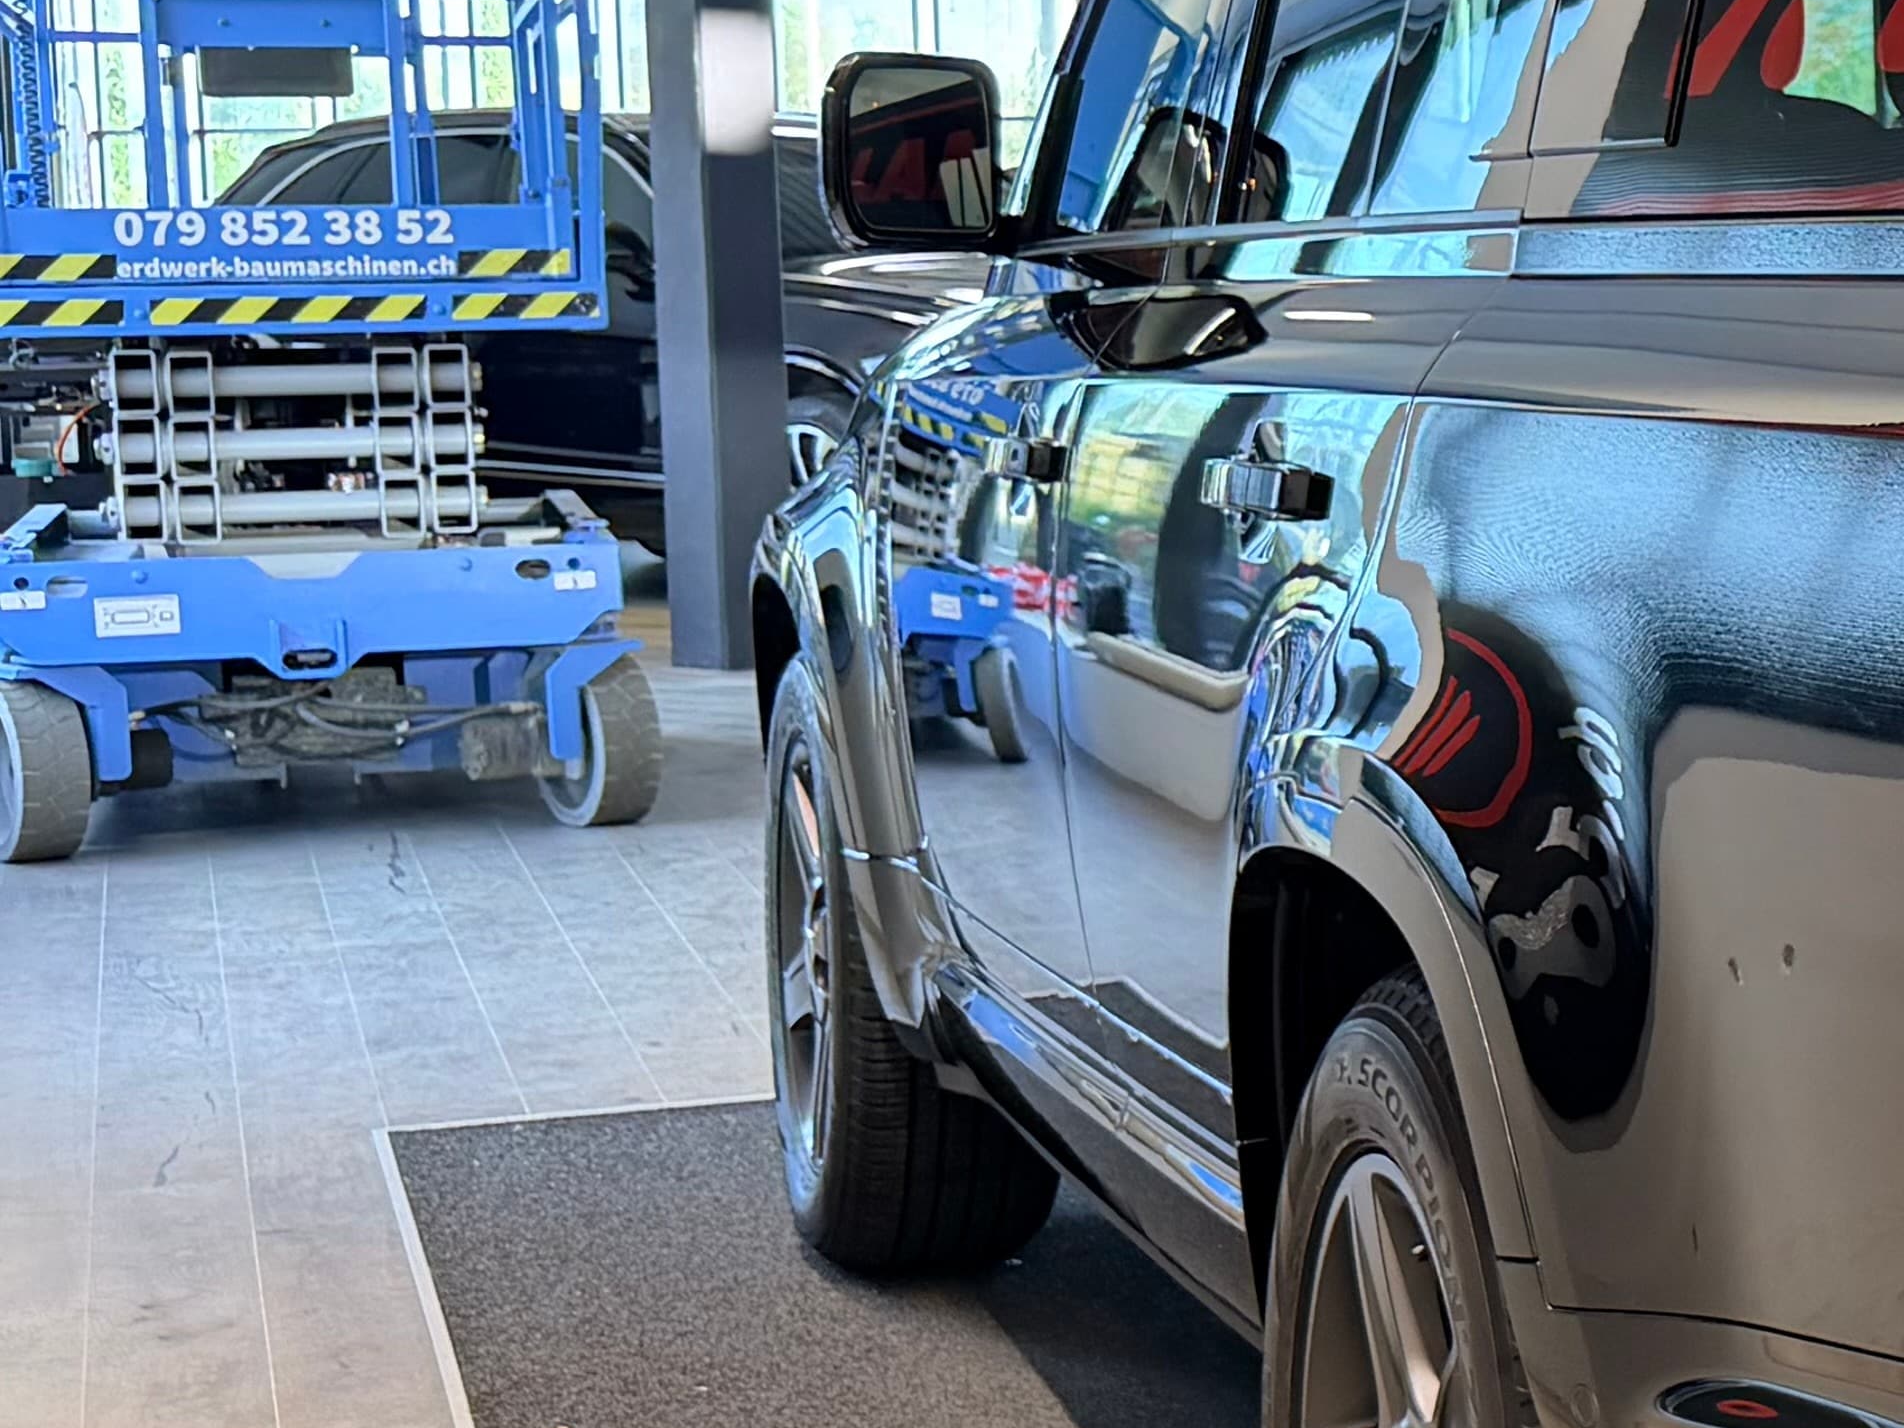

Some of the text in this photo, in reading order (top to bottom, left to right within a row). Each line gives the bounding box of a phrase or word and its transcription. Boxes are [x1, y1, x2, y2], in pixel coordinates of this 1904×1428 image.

[114, 208, 455, 247] 079 852 38 52
[116, 254, 457, 280] erdwerk-baumaschinen.ch
